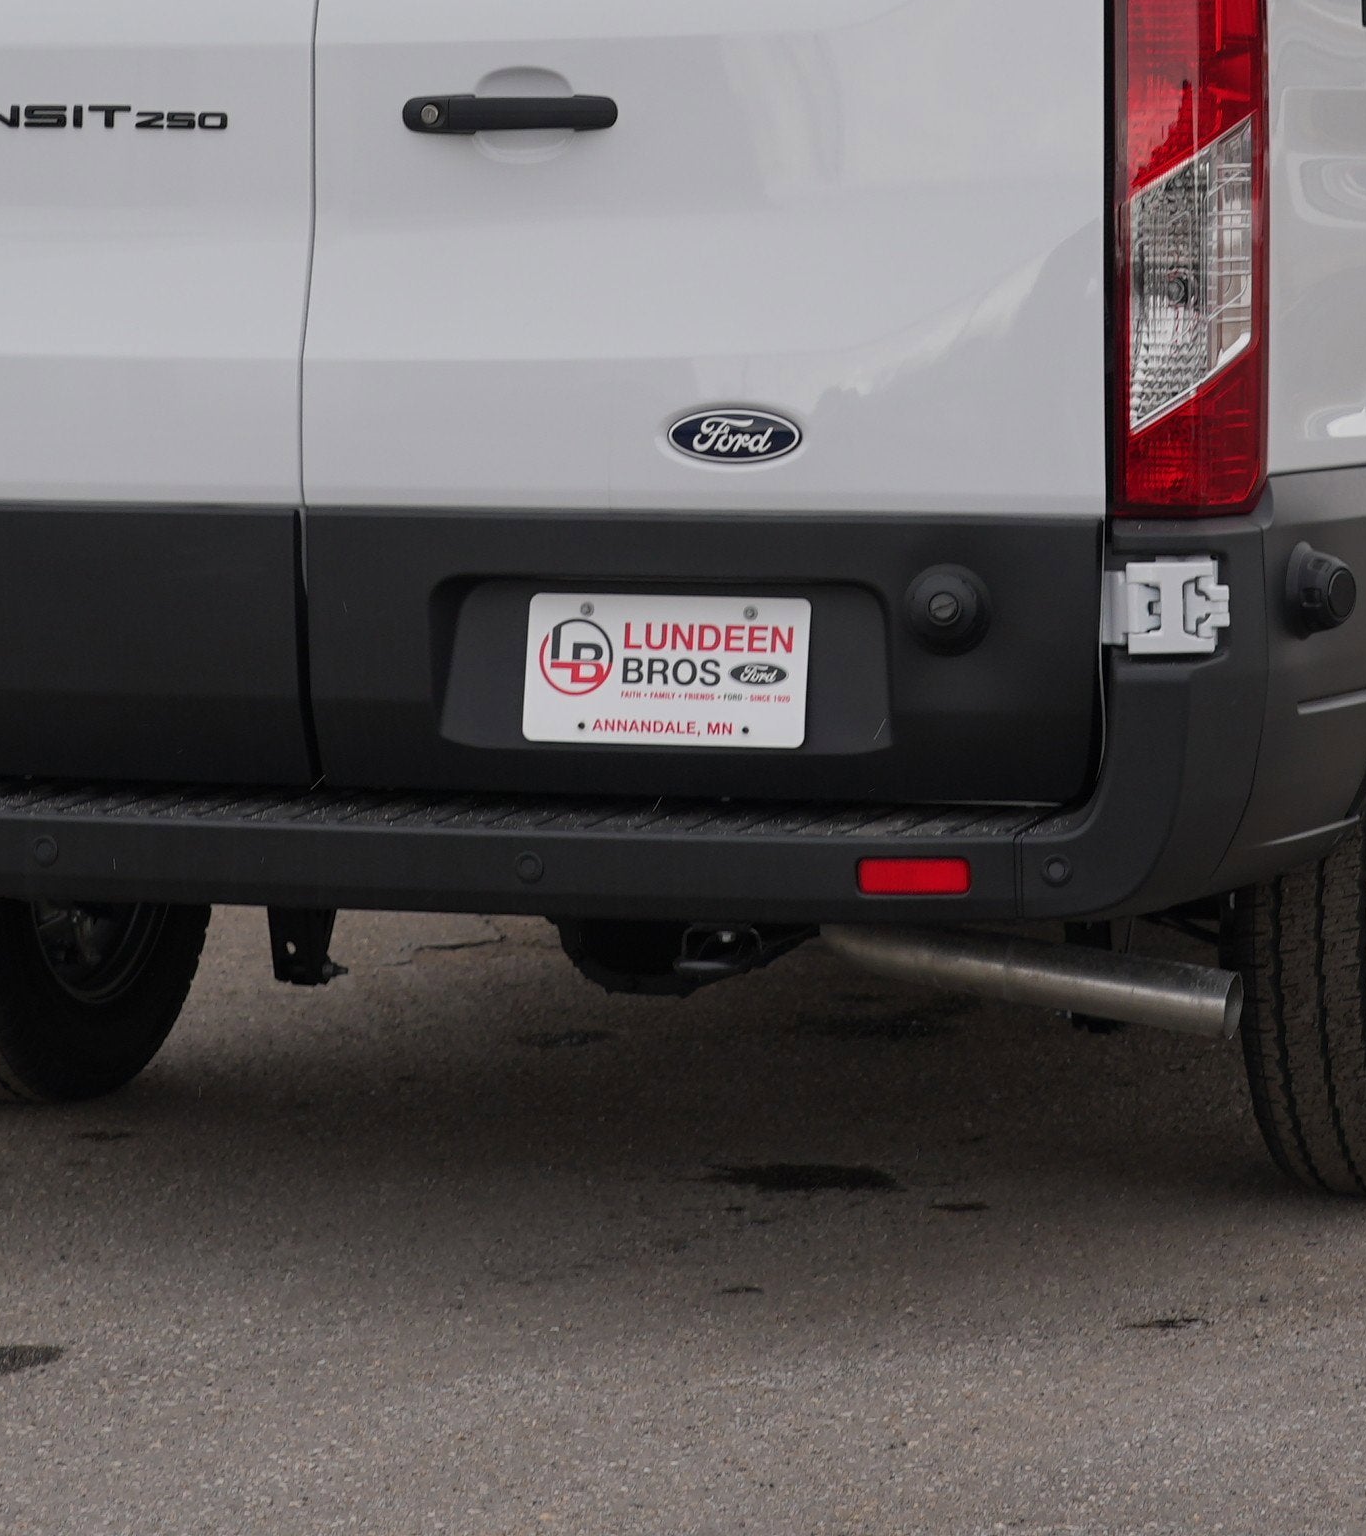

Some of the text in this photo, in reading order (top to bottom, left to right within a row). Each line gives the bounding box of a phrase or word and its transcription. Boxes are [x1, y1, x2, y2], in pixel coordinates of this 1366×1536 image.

[692, 416, 774, 453] Ford
[623, 622, 795, 654] LUNDEEN
[621, 657, 722, 687] BROS
[620, 690, 642, 700] FAITH
[649, 691, 676, 700] FAMILY
[684, 692, 715, 701] FRIENDS
[592, 718, 733, 737] ANNANDALE, MN
